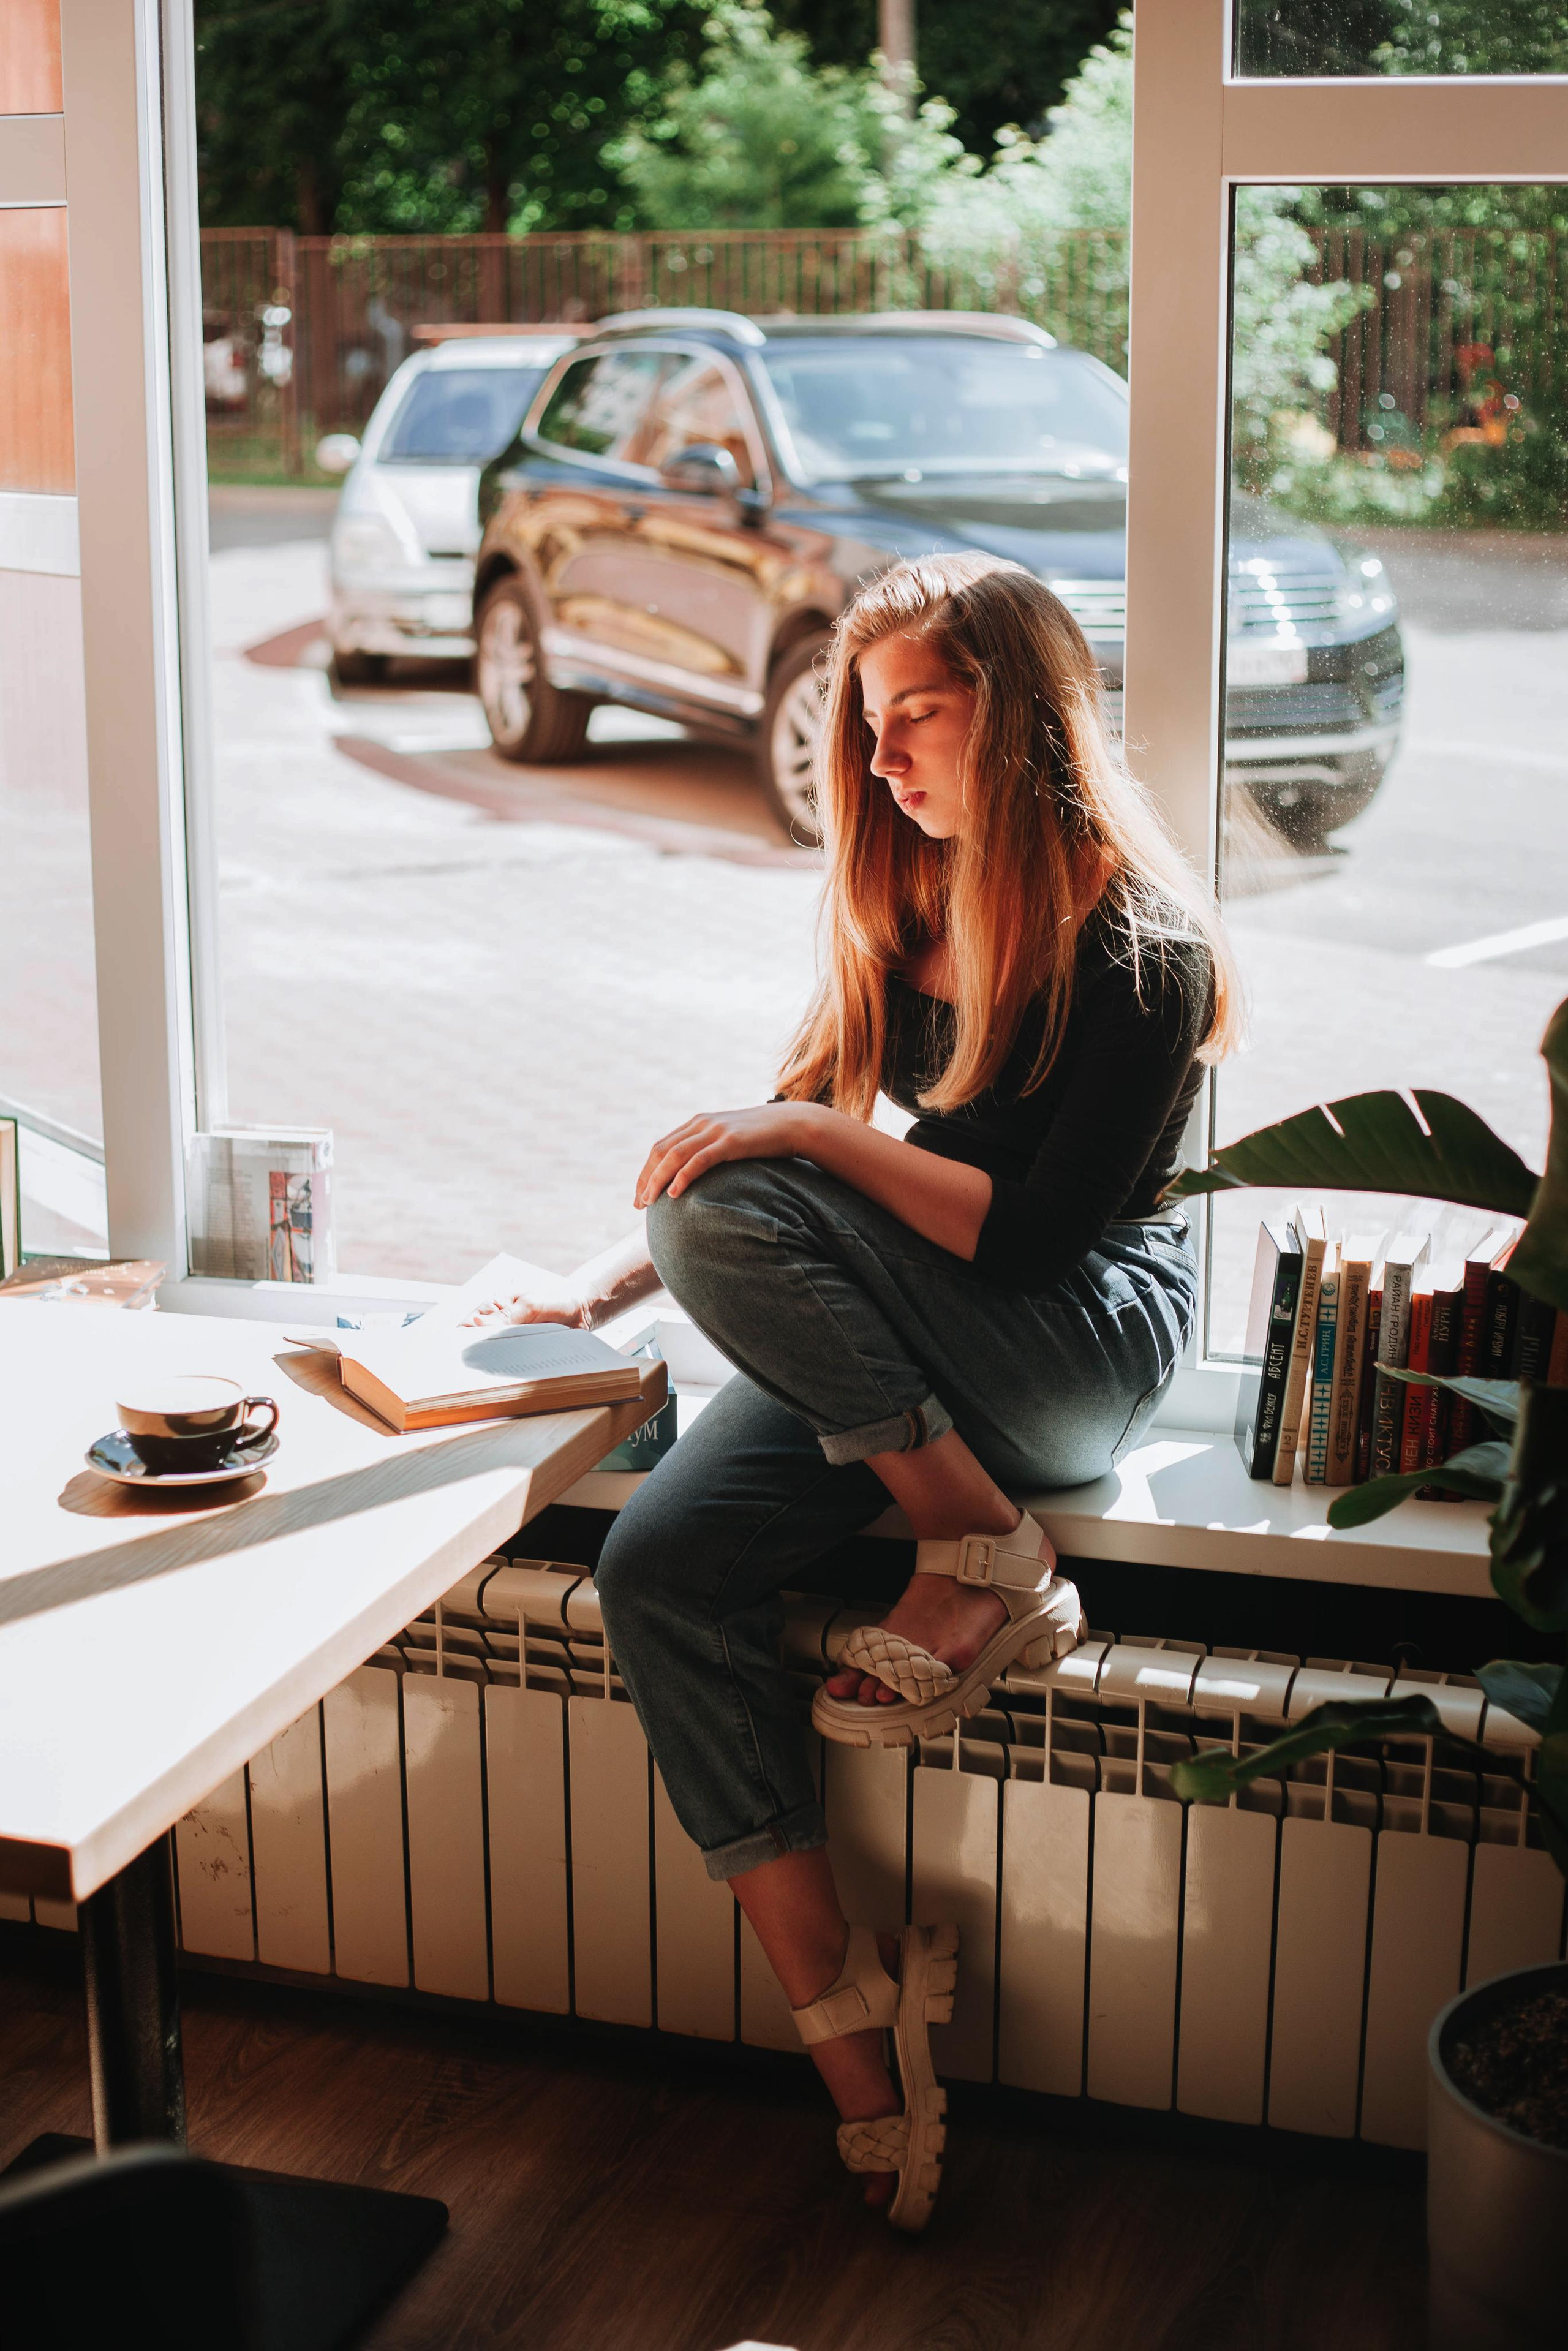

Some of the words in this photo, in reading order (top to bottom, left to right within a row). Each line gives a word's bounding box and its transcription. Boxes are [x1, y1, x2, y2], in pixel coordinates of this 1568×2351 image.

[1390, 1275, 1402, 1312] РАЙАН
[1388, 1316, 1400, 1360] ГРОДИН
[1439, 1307, 1451, 1342] НУРИ
[1268, 1343, 1284, 1379] АБСЕНТ
[1264, 1392, 1277, 1414] БЕЙКЕР
[1407, 1395, 1422, 1435] КИЗИ
[1263, 1415, 1273, 1430] ФИЛ
[1404, 1439, 1419, 1467] КЕН
[1427, 1428, 1436, 1455] СТОИТ
